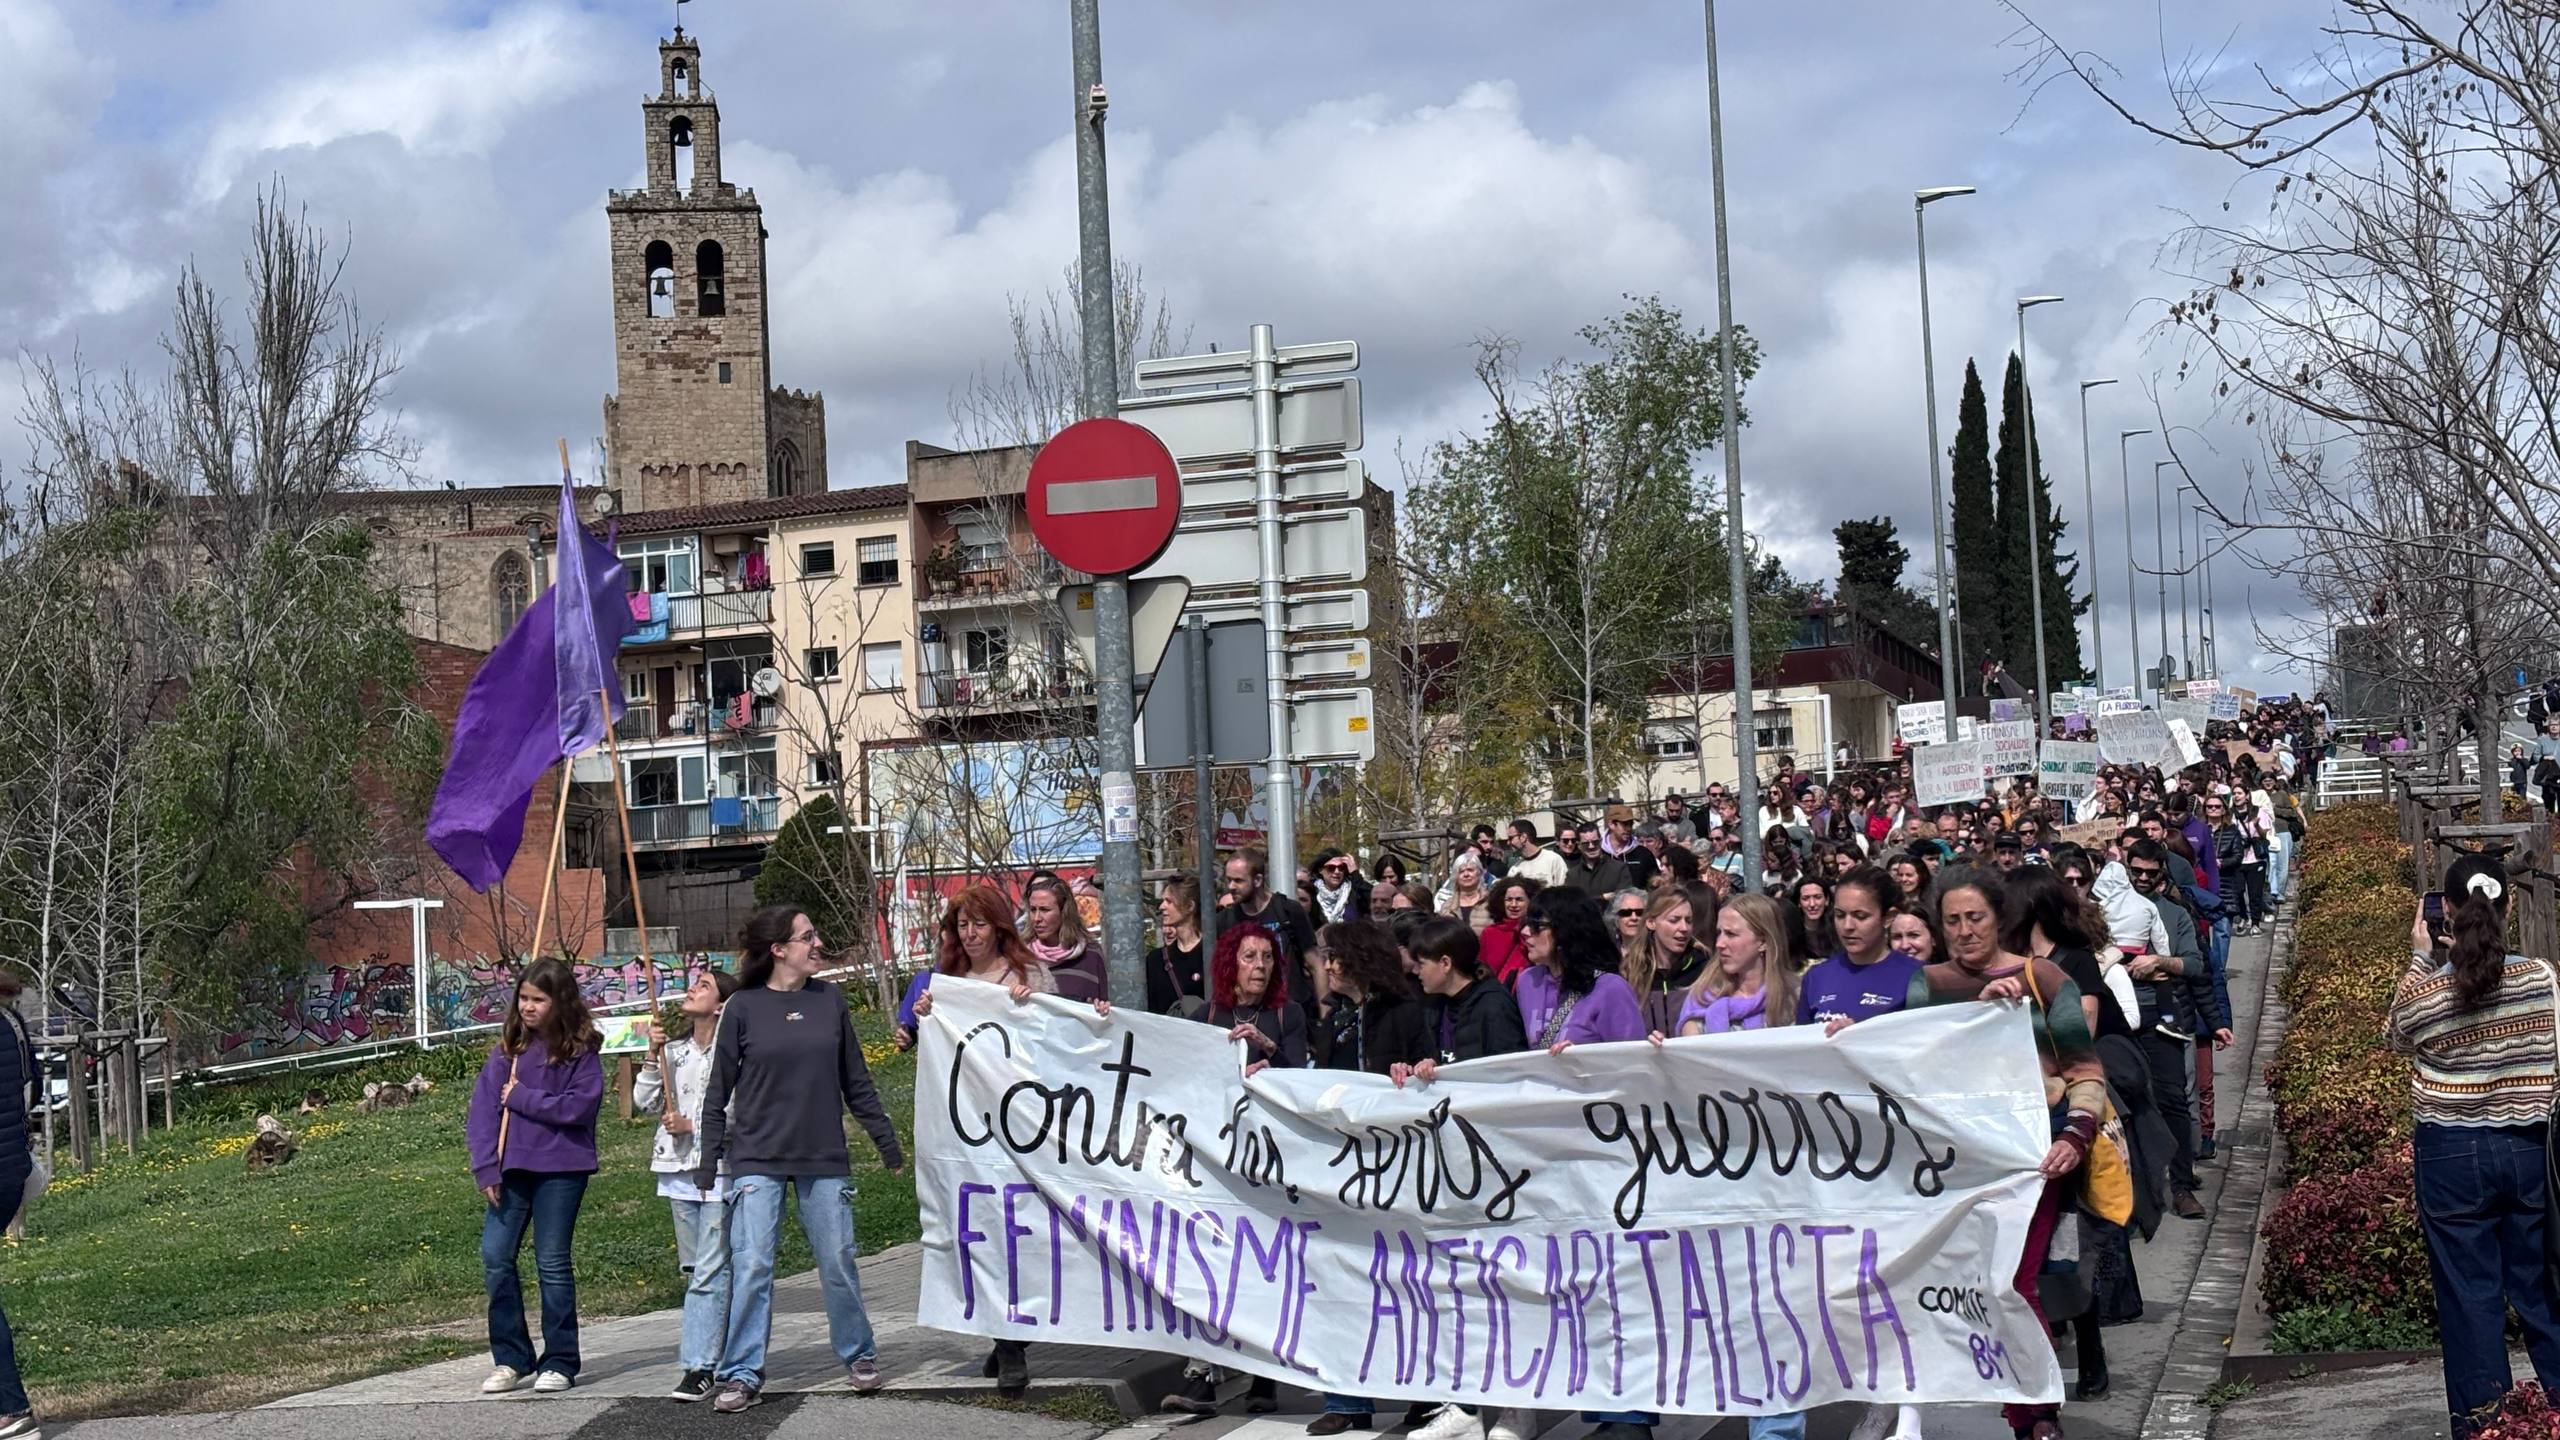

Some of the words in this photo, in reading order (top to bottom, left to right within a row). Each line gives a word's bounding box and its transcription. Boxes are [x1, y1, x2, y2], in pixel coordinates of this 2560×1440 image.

[949, 1021, 1203, 1188] Contra
[1583, 1082, 1956, 1230] guerres
[957, 1181, 1323, 1377] FEMINISME
[1358, 1222, 1917, 1411] ANTICAPITALISTA
[1969, 1332, 2021, 1385] 8M
